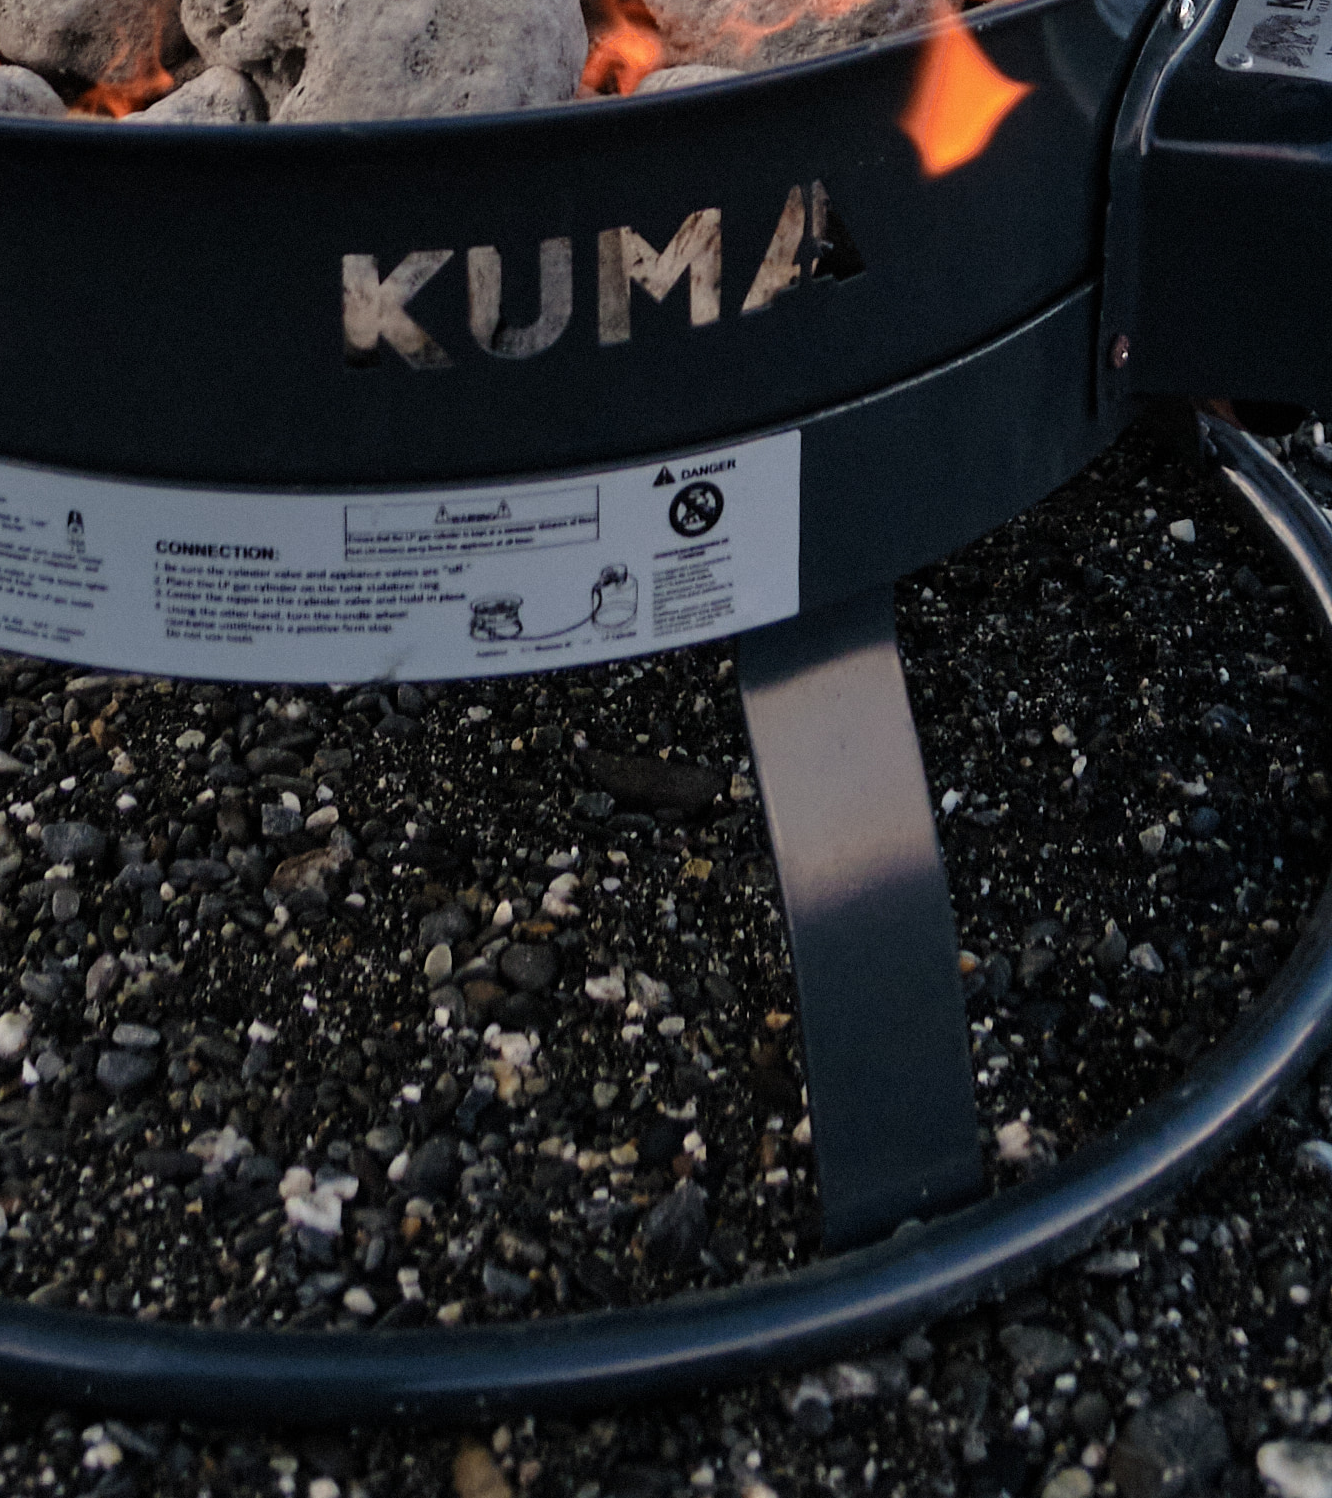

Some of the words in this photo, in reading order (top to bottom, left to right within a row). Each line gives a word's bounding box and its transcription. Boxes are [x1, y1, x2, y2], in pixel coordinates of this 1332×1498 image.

[342, 178, 868, 371] KUMA
[681, 458, 737, 480] DANGER
[155, 539, 280, 562] CONNECTION:
[217, 580, 230, 590] LP
